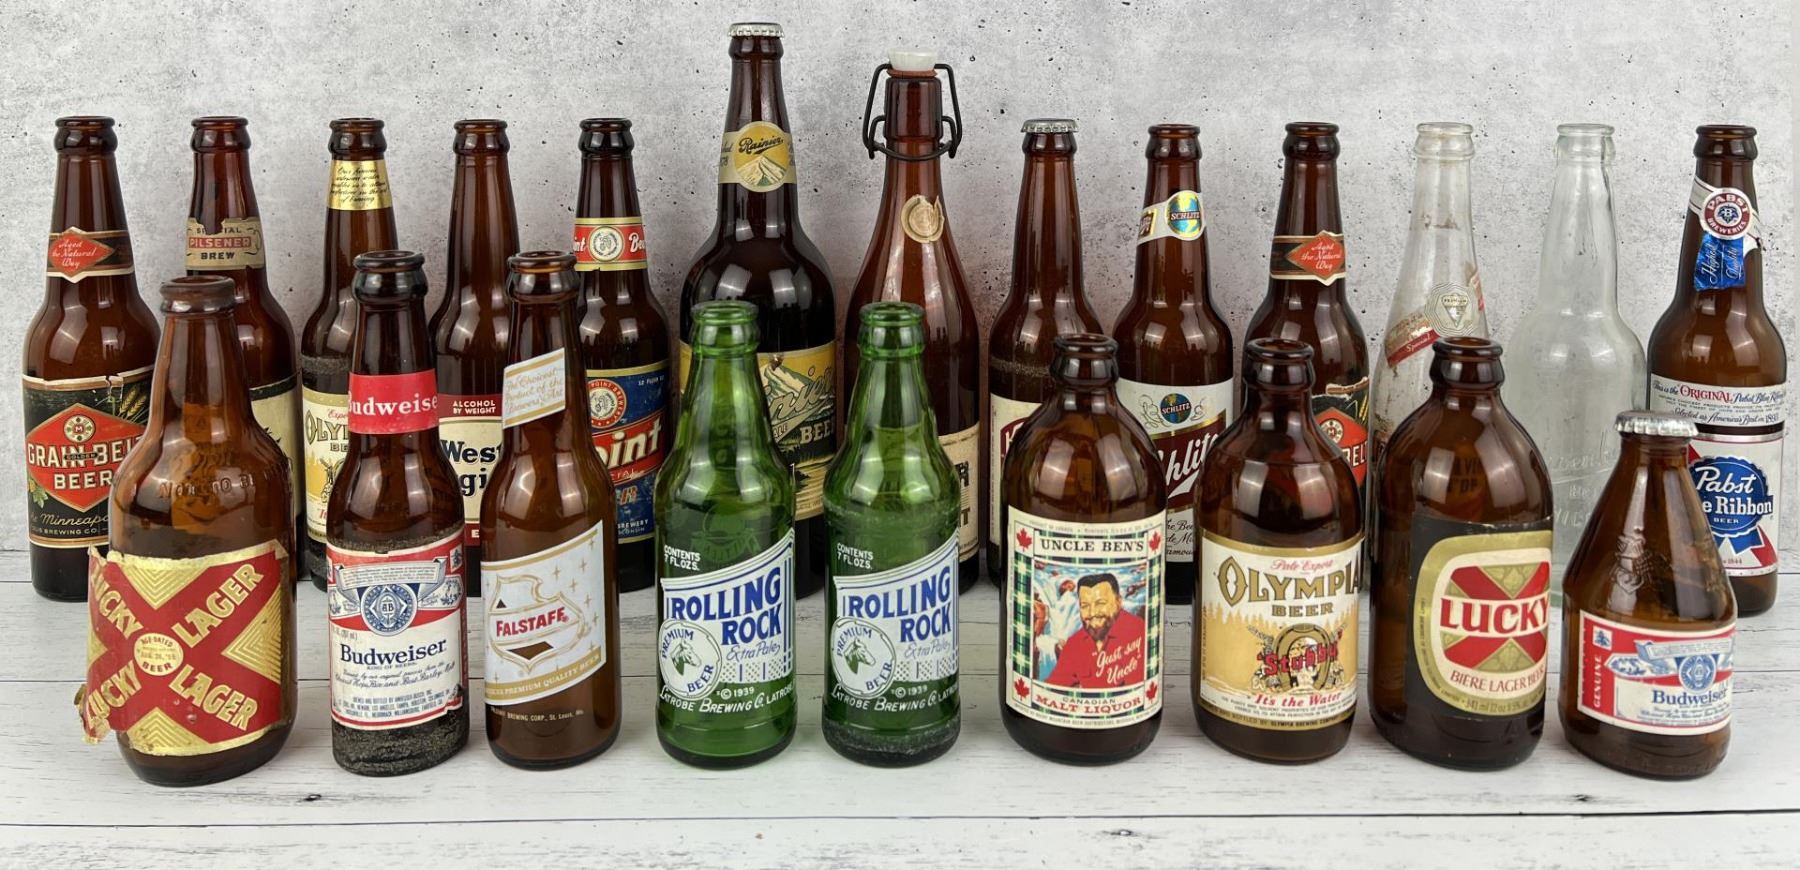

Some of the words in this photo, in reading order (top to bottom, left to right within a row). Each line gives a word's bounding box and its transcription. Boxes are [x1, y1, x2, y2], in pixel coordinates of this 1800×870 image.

[739, 135, 784, 154] Rainier
[1708, 194, 1748, 212] PABST
[61, 247, 96, 258] Natural
[190, 238, 250, 248] PILSENER
[62, 258, 81, 268] Way
[201, 252, 235, 260] BREW
[1316, 260, 1333, 272] Way
[348, 390, 438, 417] udweise
[453, 400, 496, 408] ALCOHOL
[1679, 385, 1733, 404] ORIGINAL
[465, 406, 497, 415] WEIGHT
[1161, 400, 1191, 415] SCHLITZ
[28, 442, 86, 468] GRAIN
[54, 470, 113, 490] BEER
[1694, 466, 1757, 494] Pabst
[1715, 496, 1773, 516] Ribbon
[664, 545, 701, 561] CONTENTS
[837, 543, 874, 560] CONTENTS
[1041, 539, 1095, 551] UNCLE
[1103, 539, 1144, 552] BEN'S
[1270, 559, 1300, 571] Pale
[1303, 559, 1334, 572] Export
[671, 566, 781, 621] ROLLING
[849, 565, 951, 619] ROLLING
[171, 563, 265, 648] LAGER
[1271, 602, 1334, 618] BEER
[721, 602, 782, 645] ROCK
[900, 602, 952, 643] ROCK
[1440, 597, 1548, 634] LUCKY
[662, 628, 695, 659] PREMIUM
[726, 644, 756, 661] Extra
[756, 641, 781, 656] Pale
[837, 626, 873, 657] PREMIUM
[904, 642, 930, 659] Extra
[930, 639, 950, 655] Pale
[1123, 637, 1142, 656] say
[340, 639, 448, 666] Budweiser
[142, 661, 173, 672] BEER
[506, 682, 541, 695] PREMIUM
[543, 668, 579, 687] QUALITY
[687, 664, 714, 693] BEER
[866, 662, 893, 691] BEER
[1489, 677, 1527, 692] LAGER
[1593, 656, 1602, 708] GENUINE
[169, 663, 258, 731] LAGER
[733, 687, 755, 698] 1939
[908, 685, 928, 696] 1939
[1281, 694, 1304, 707] the
[1308, 691, 1342, 706] Water
[1652, 687, 1728, 706] Budweiser
[700, 697, 753, 713] BREWING
[874, 697, 926, 713] BREWING
[1036, 694, 1078, 713] MALT
[1084, 694, 1142, 714] LIQUOR
